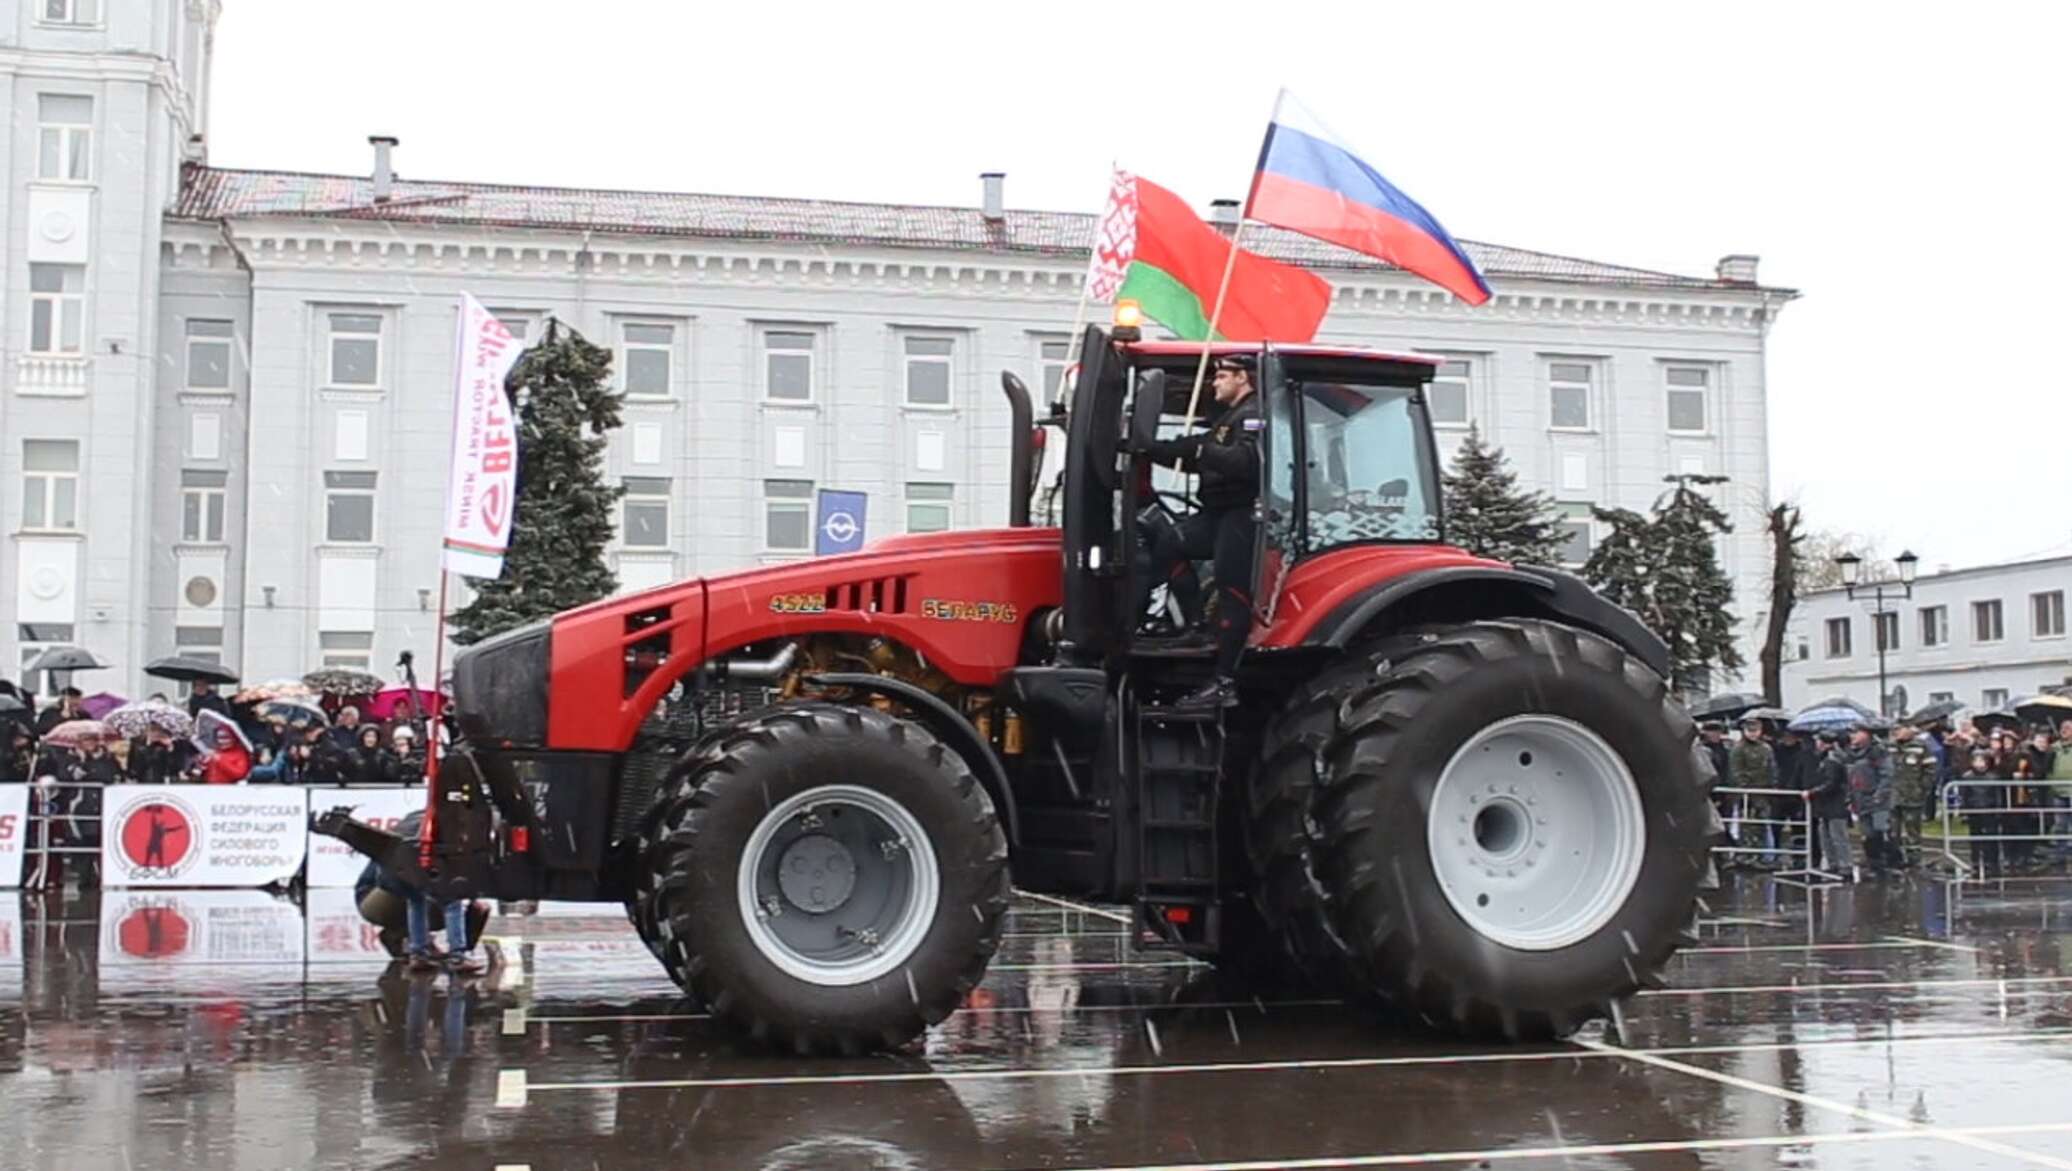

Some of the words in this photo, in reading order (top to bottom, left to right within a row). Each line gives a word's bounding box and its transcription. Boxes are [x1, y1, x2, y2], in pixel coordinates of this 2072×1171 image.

[769, 594, 826, 613] 4522
[922, 599, 1016, 623] БЕЛАРУС
[211, 804, 301, 817] БЕЛОРУССКАЯ
[211, 821, 287, 834] ФЕДЕРАЦИЯ
[210, 838, 279, 850] СИЛОВОГО
